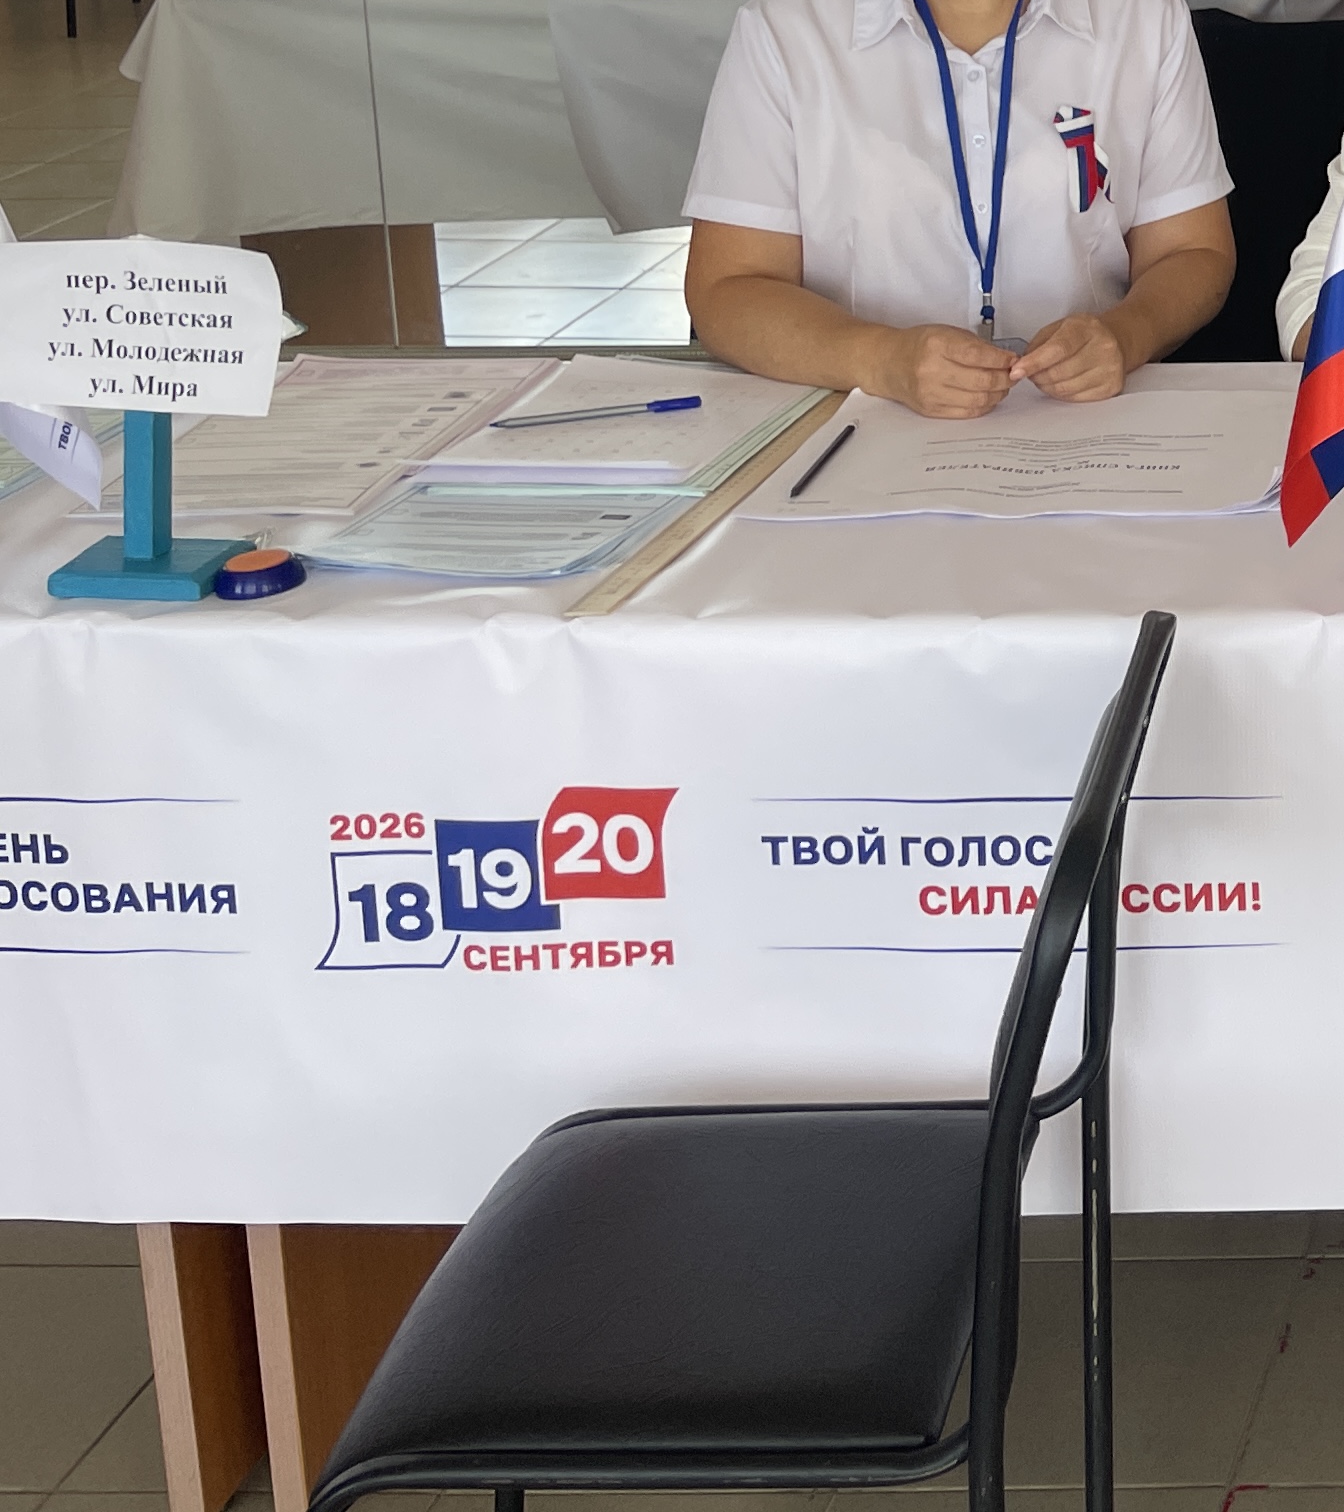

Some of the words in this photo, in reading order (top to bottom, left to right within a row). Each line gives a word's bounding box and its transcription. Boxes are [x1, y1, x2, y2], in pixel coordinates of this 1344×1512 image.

[66, 273, 116, 294] пер.
[123, 271, 228, 295] Зеленый
[62, 307, 97, 328] ул.
[105, 304, 233, 329] Советская
[47, 341, 83, 362] ул.
[91, 338, 244, 364] Молодежная
[88, 377, 123, 398] ул.
[131, 374, 198, 402] Мира
[58, 421, 73, 450] ТВО
[329, 812, 426, 841] 2026
[0, 833, 70, 864] НЬ
[761, 827, 886, 867] ТВОЙ
[900, 834, 1053, 867] ГОЛОС
[348, 882, 434, 943] 18
[448, 848, 532, 910] 19
[551, 812, 654, 875] 20
[0, 879, 238, 915] ОСОВАНИЯ
[1121, 881, 1262, 914] ССИИ!
[463, 939, 675, 972] СЕНТЯБРЯ
